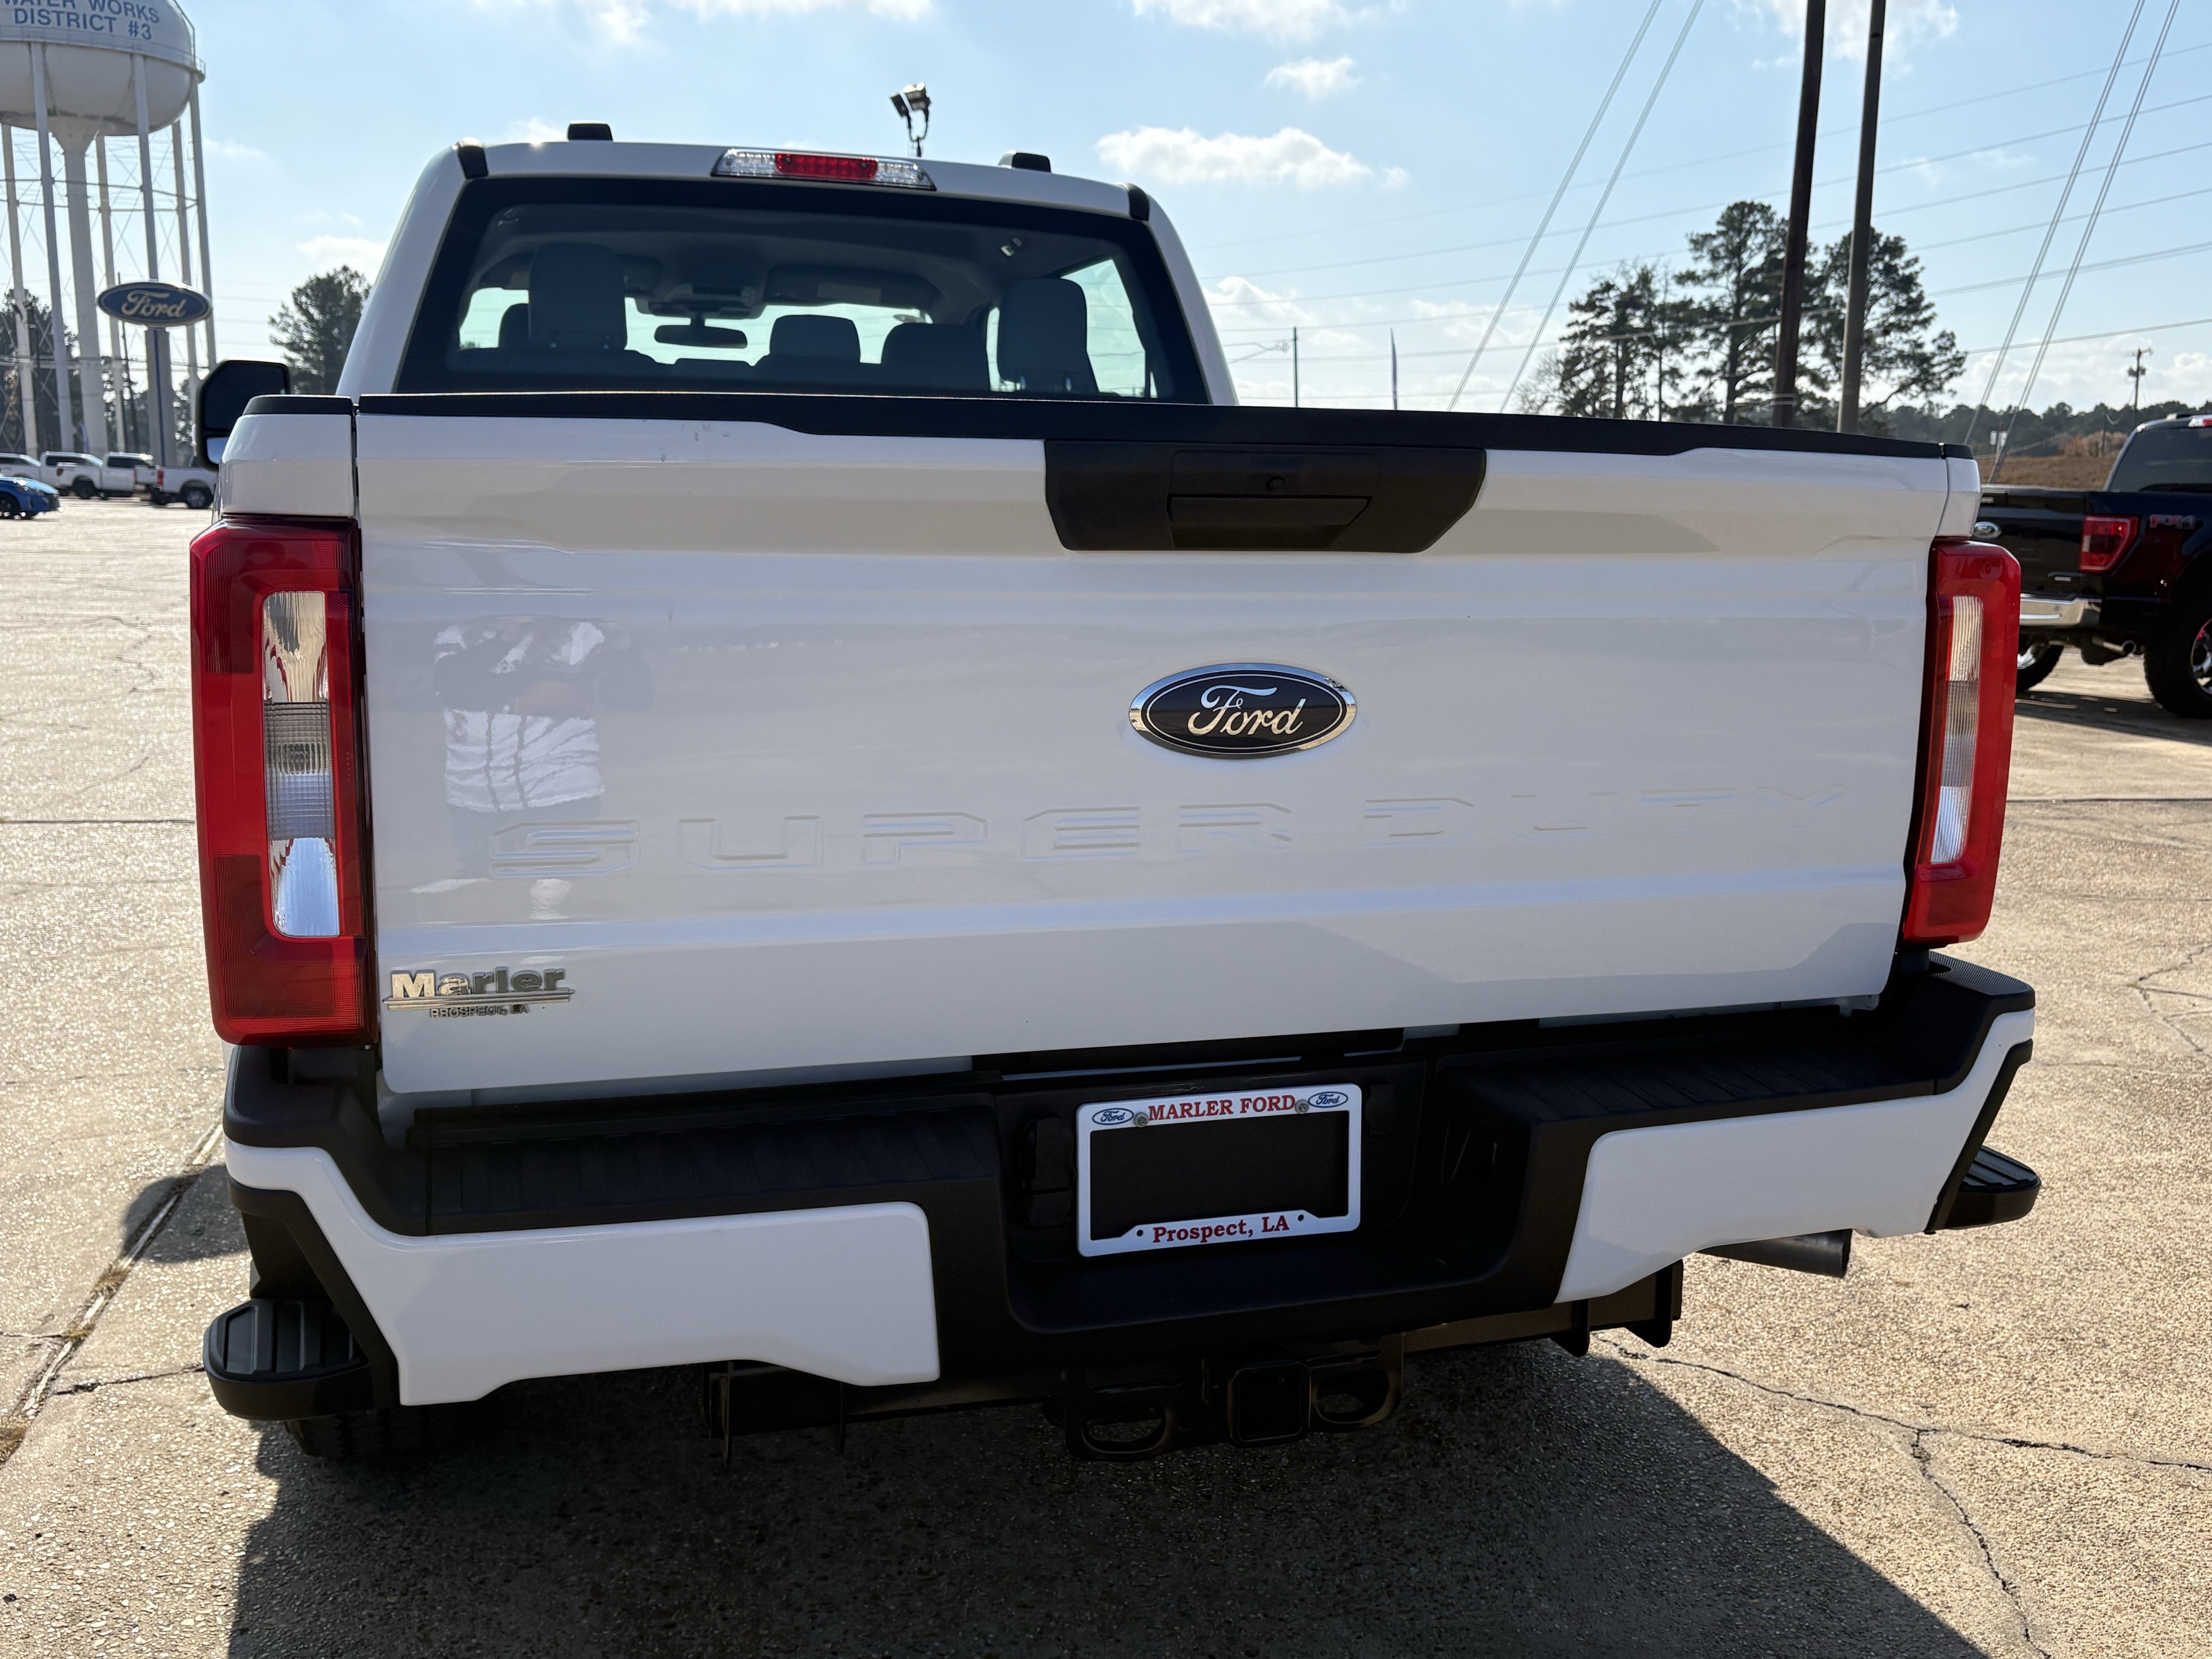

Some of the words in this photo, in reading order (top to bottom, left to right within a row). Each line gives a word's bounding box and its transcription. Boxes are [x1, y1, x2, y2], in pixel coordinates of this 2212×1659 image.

[14, 8, 117, 33] DISTRICT
[128, 20, 152, 40] #3
[88, 0, 159, 23] WORKS
[121, 290, 187, 318] Ford
[2150, 514, 2196, 529] FX4
[1187, 685, 1306, 736] Ford
[489, 801, 1294, 878] SUPER
[390, 967, 567, 998] Marler
[510, 1004, 529, 1015] LA
[1148, 1097, 1233, 1121] MARLER
[1240, 1094, 1296, 1113] FORD
[1316, 1094, 1340, 1105] Ford
[1100, 1110, 1125, 1122] Ford
[1152, 1219, 1254, 1243] Prospect,
[1261, 1215, 1290, 1232] LA
